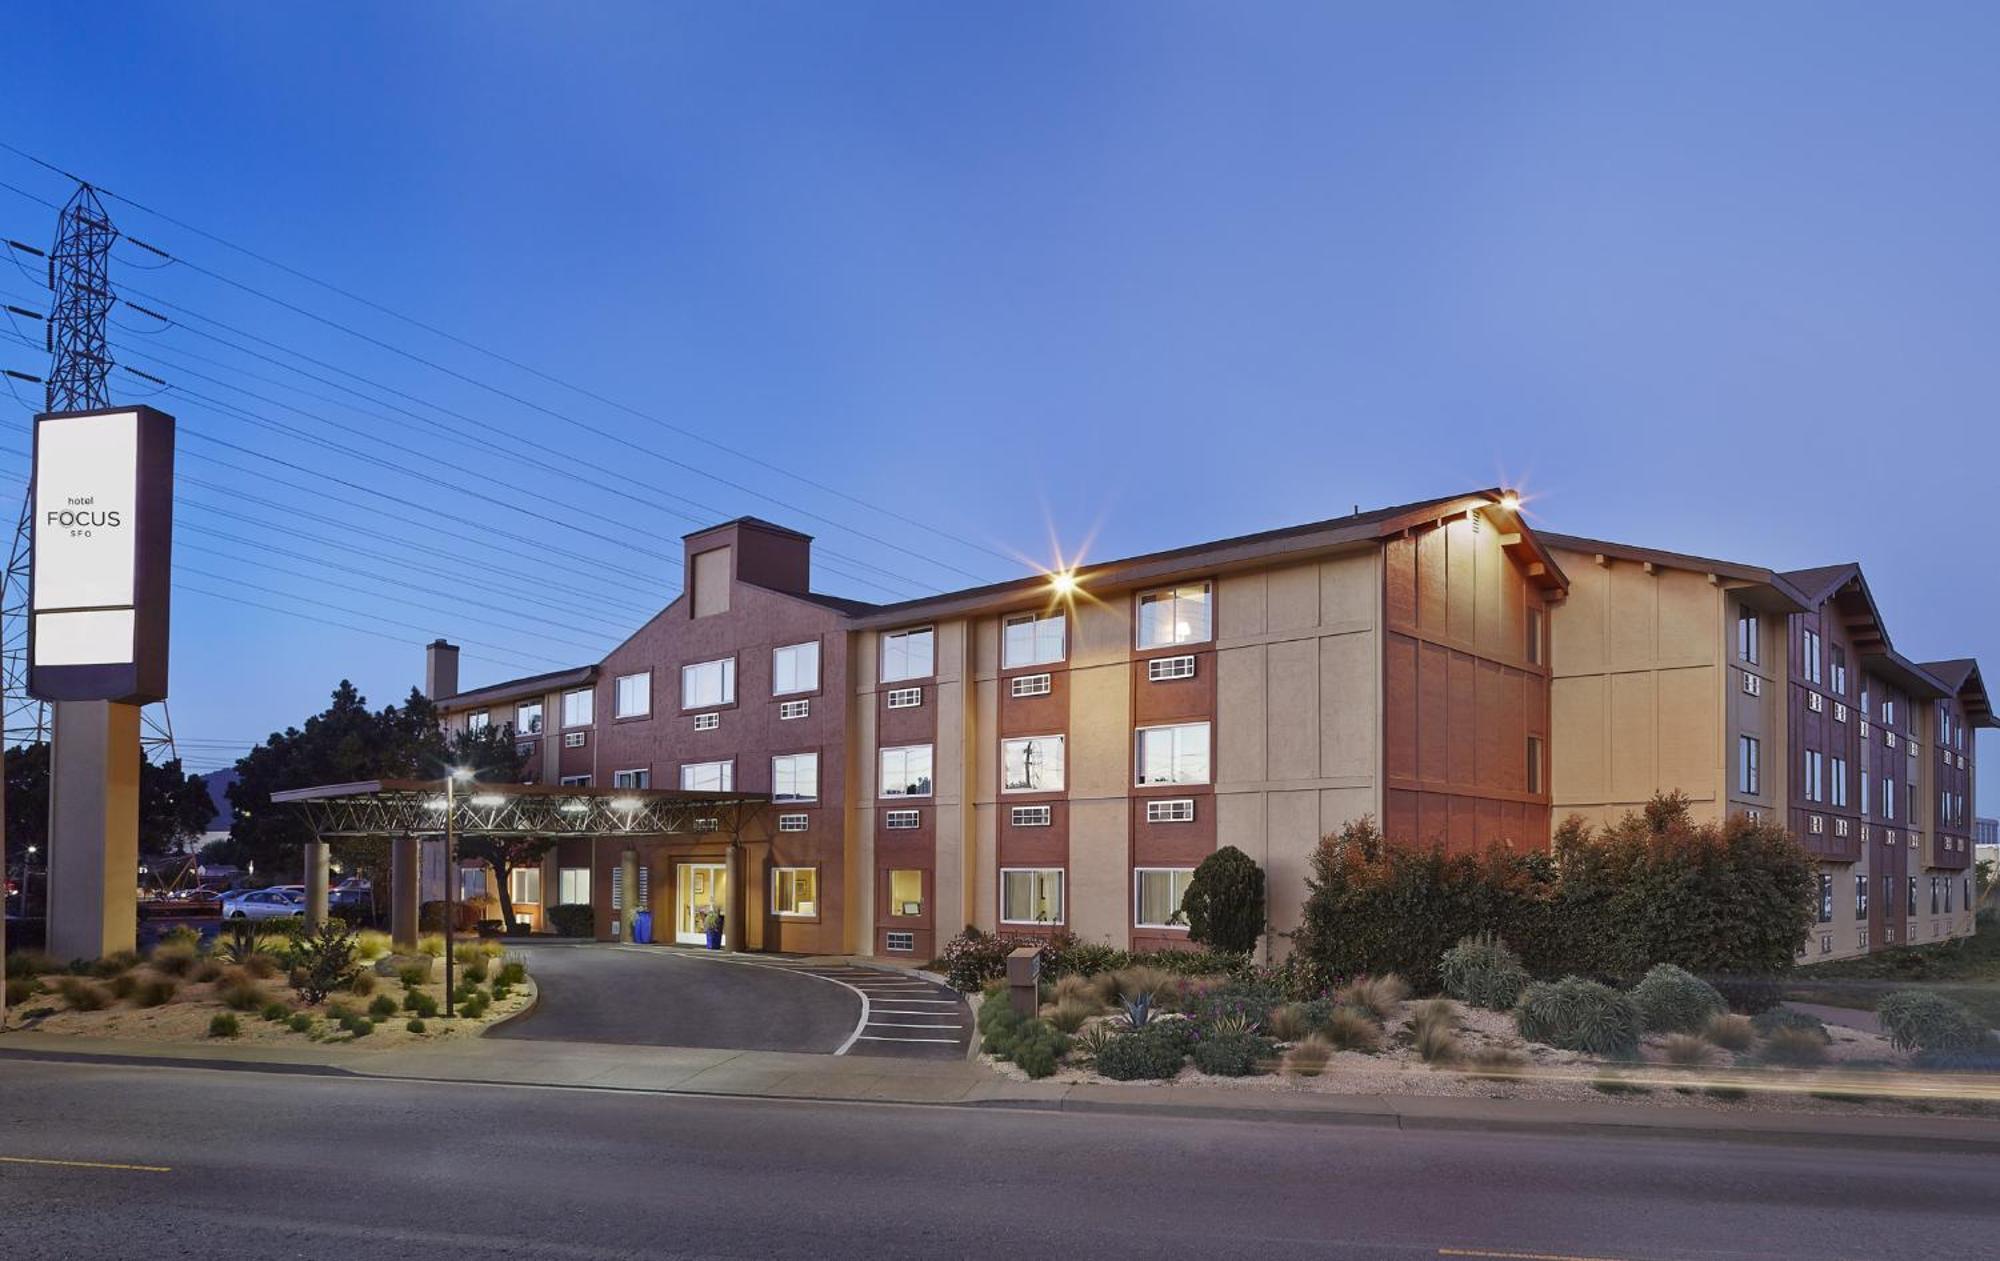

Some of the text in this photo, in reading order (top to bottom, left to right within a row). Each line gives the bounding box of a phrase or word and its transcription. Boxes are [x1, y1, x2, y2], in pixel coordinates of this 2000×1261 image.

[67, 496, 94, 505] hotel
[47, 511, 121, 527] FOCUS
[70, 530, 92, 538] SFO
